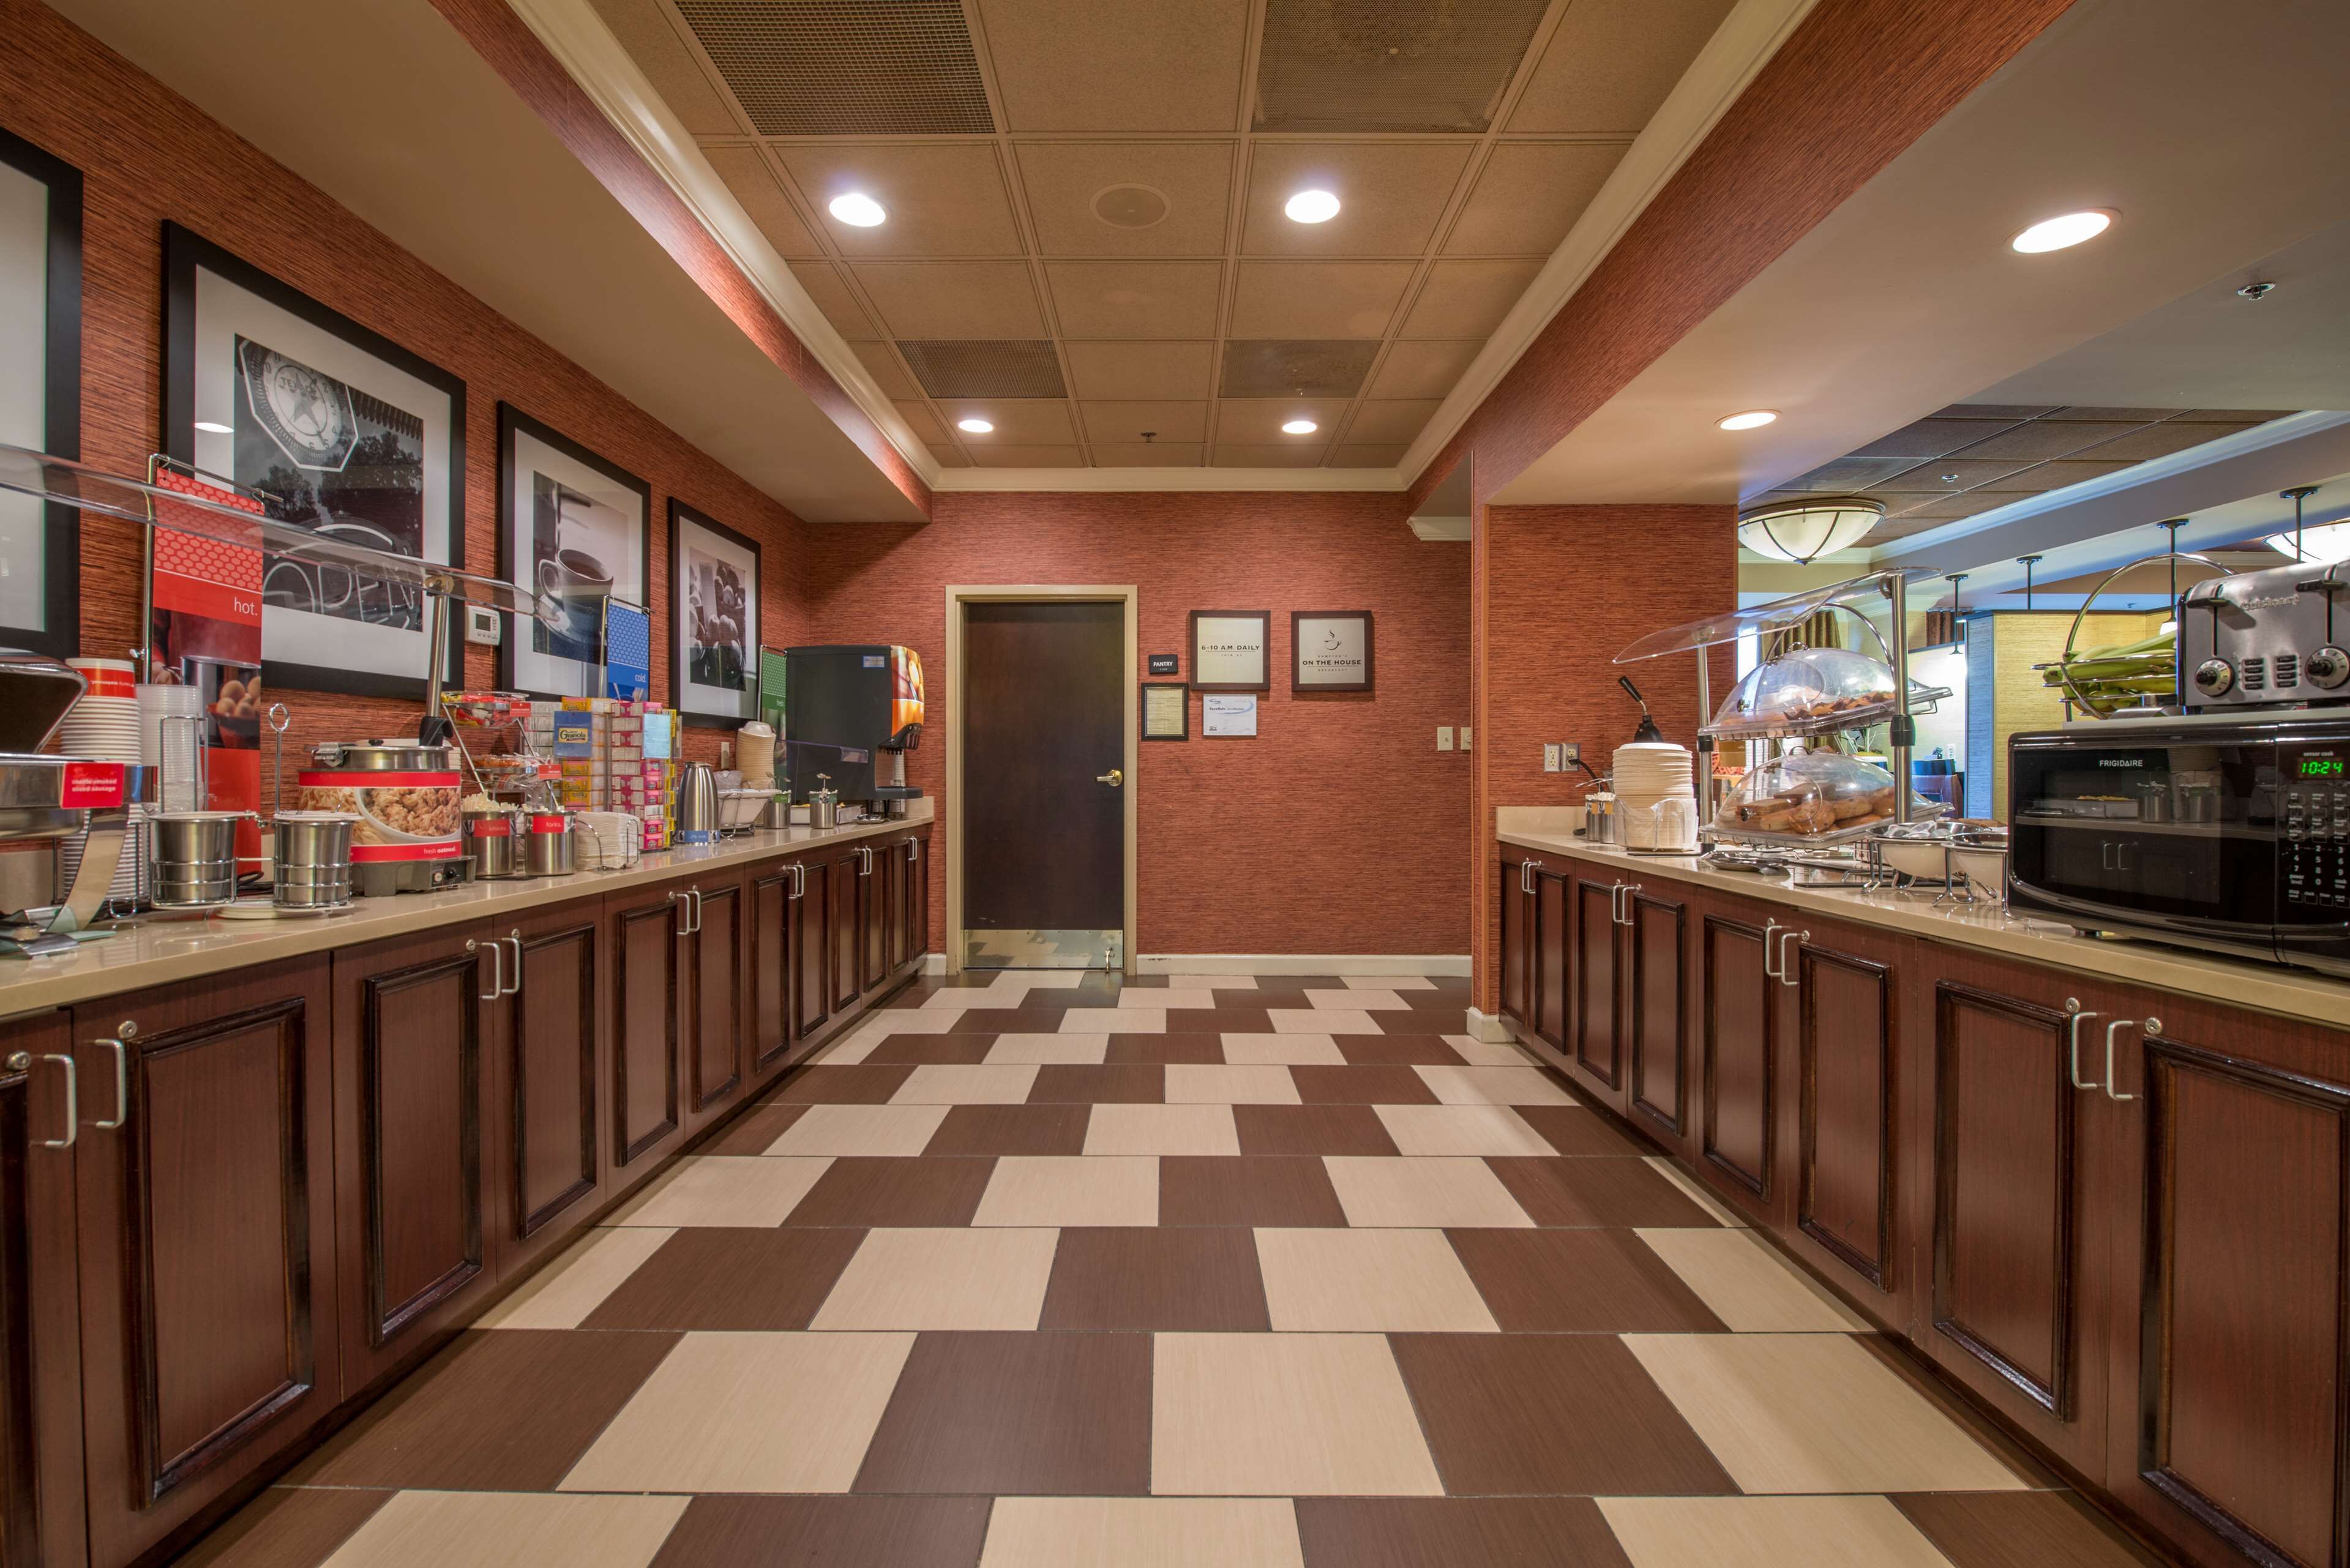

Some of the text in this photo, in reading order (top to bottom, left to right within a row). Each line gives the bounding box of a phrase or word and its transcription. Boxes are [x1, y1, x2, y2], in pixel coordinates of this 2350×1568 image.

[234, 597, 258, 616] hot.
[635, 673, 647, 683] cold.
[559, 730, 586, 740] Granola
[2302, 761, 2343, 774] 10:24
